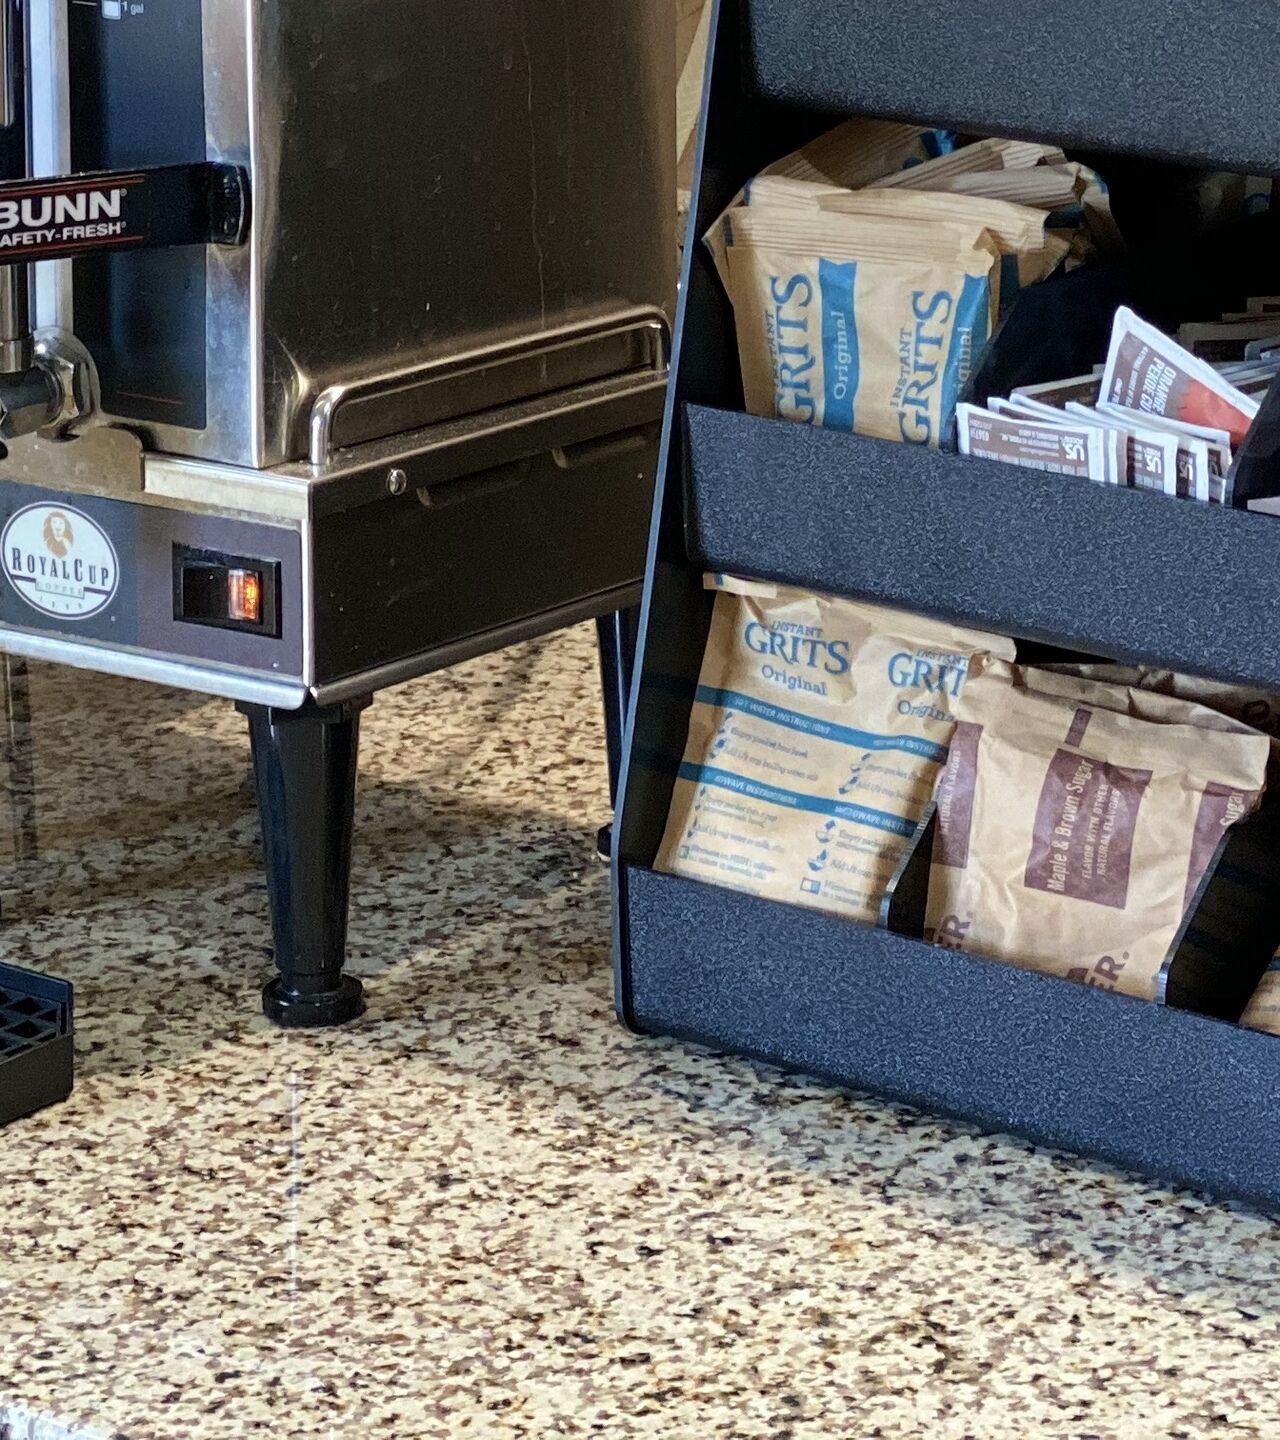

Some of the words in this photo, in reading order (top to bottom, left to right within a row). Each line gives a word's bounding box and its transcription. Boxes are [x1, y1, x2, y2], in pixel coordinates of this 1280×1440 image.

[130, 3, 144, 16] gal
[771, 274, 816, 424] GRITS
[832, 311, 849, 401] Original
[891, 327, 912, 408] INSTANT
[899, 290, 952, 445] GRITS
[1146, 357, 1164, 399] PEKOE
[1152, 365, 1177, 417] ORANGE
[744, 622, 850, 675] GRITS
[771, 620, 824, 638] INSTANT
[761, 664, 829, 697] Original
[888, 652, 966, 698] GRIT
[750, 700, 777, 718] WATER
[897, 699, 956, 723] Origina
[945, 750, 962, 790] FLAVORS
[1066, 760, 1095, 794] Sugar
[1055, 792, 1081, 840] Brown
[1093, 784, 1110, 816] OTHER
[1220, 792, 1245, 827] Sugar
[1054, 840, 1069, 851] &
[1087, 818, 1100, 843] WITH
[1097, 835, 1111, 876] NATURAL
[1104, 789, 1121, 835] FLAVORS
[1047, 853, 1067, 892] Maple
[1081, 846, 1093, 879] FLAVOR
